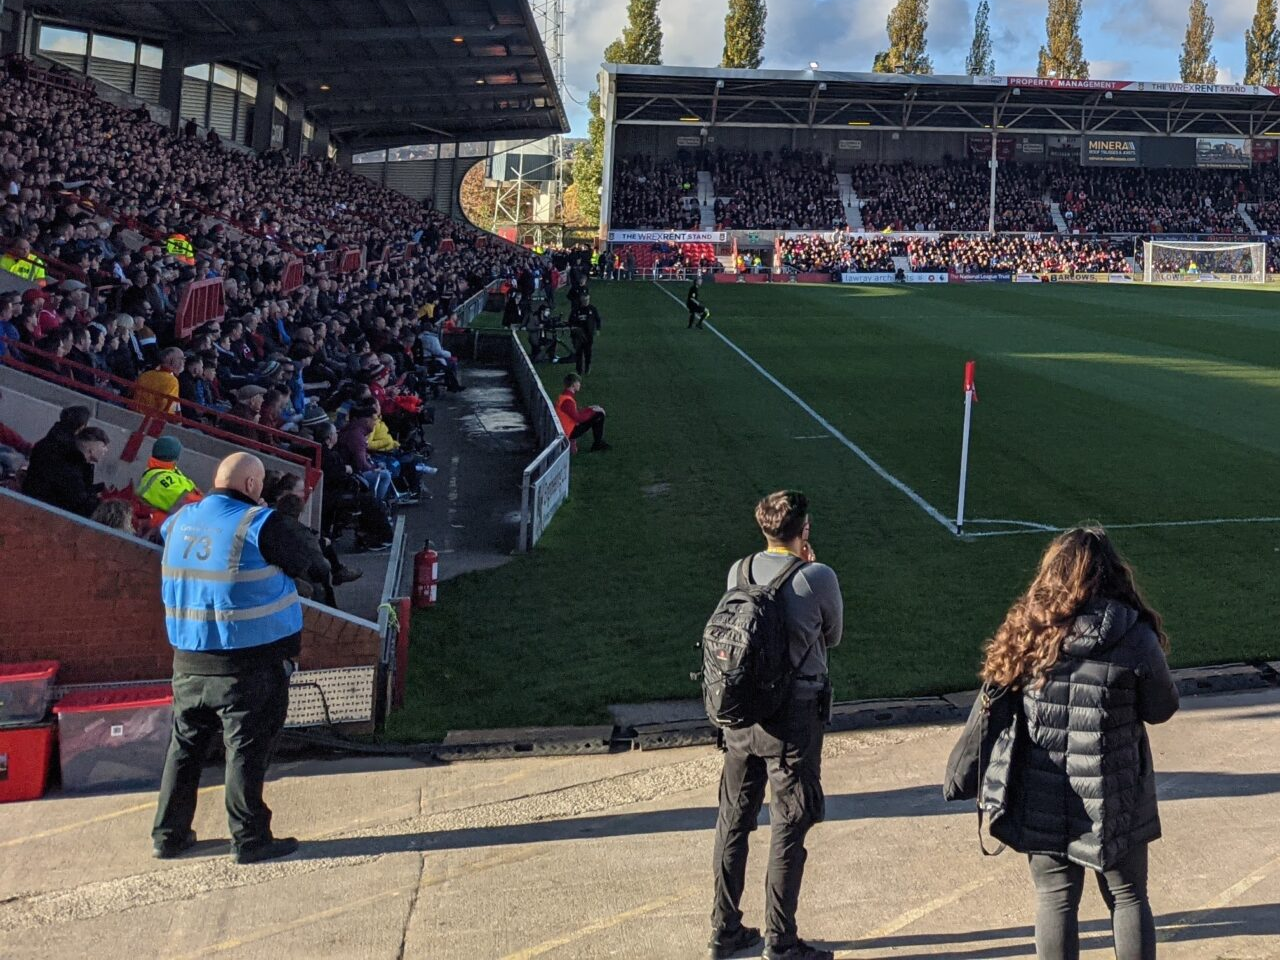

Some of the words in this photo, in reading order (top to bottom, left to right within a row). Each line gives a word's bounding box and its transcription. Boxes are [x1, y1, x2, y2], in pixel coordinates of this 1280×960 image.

[1010, 77, 1055, 87] PROPERTY
[1057, 80, 1117, 90] MANAGEMENT
[1152, 83, 1169, 91] THE
[1169, 83, 1218, 93] WREXRENT
[1088, 140, 1129, 150] MINERA
[638, 233, 687, 241] WREXRENT
[845, 273, 872, 283] lawray
[160, 476, 175, 488] 62
[183, 536, 211, 560] 73
